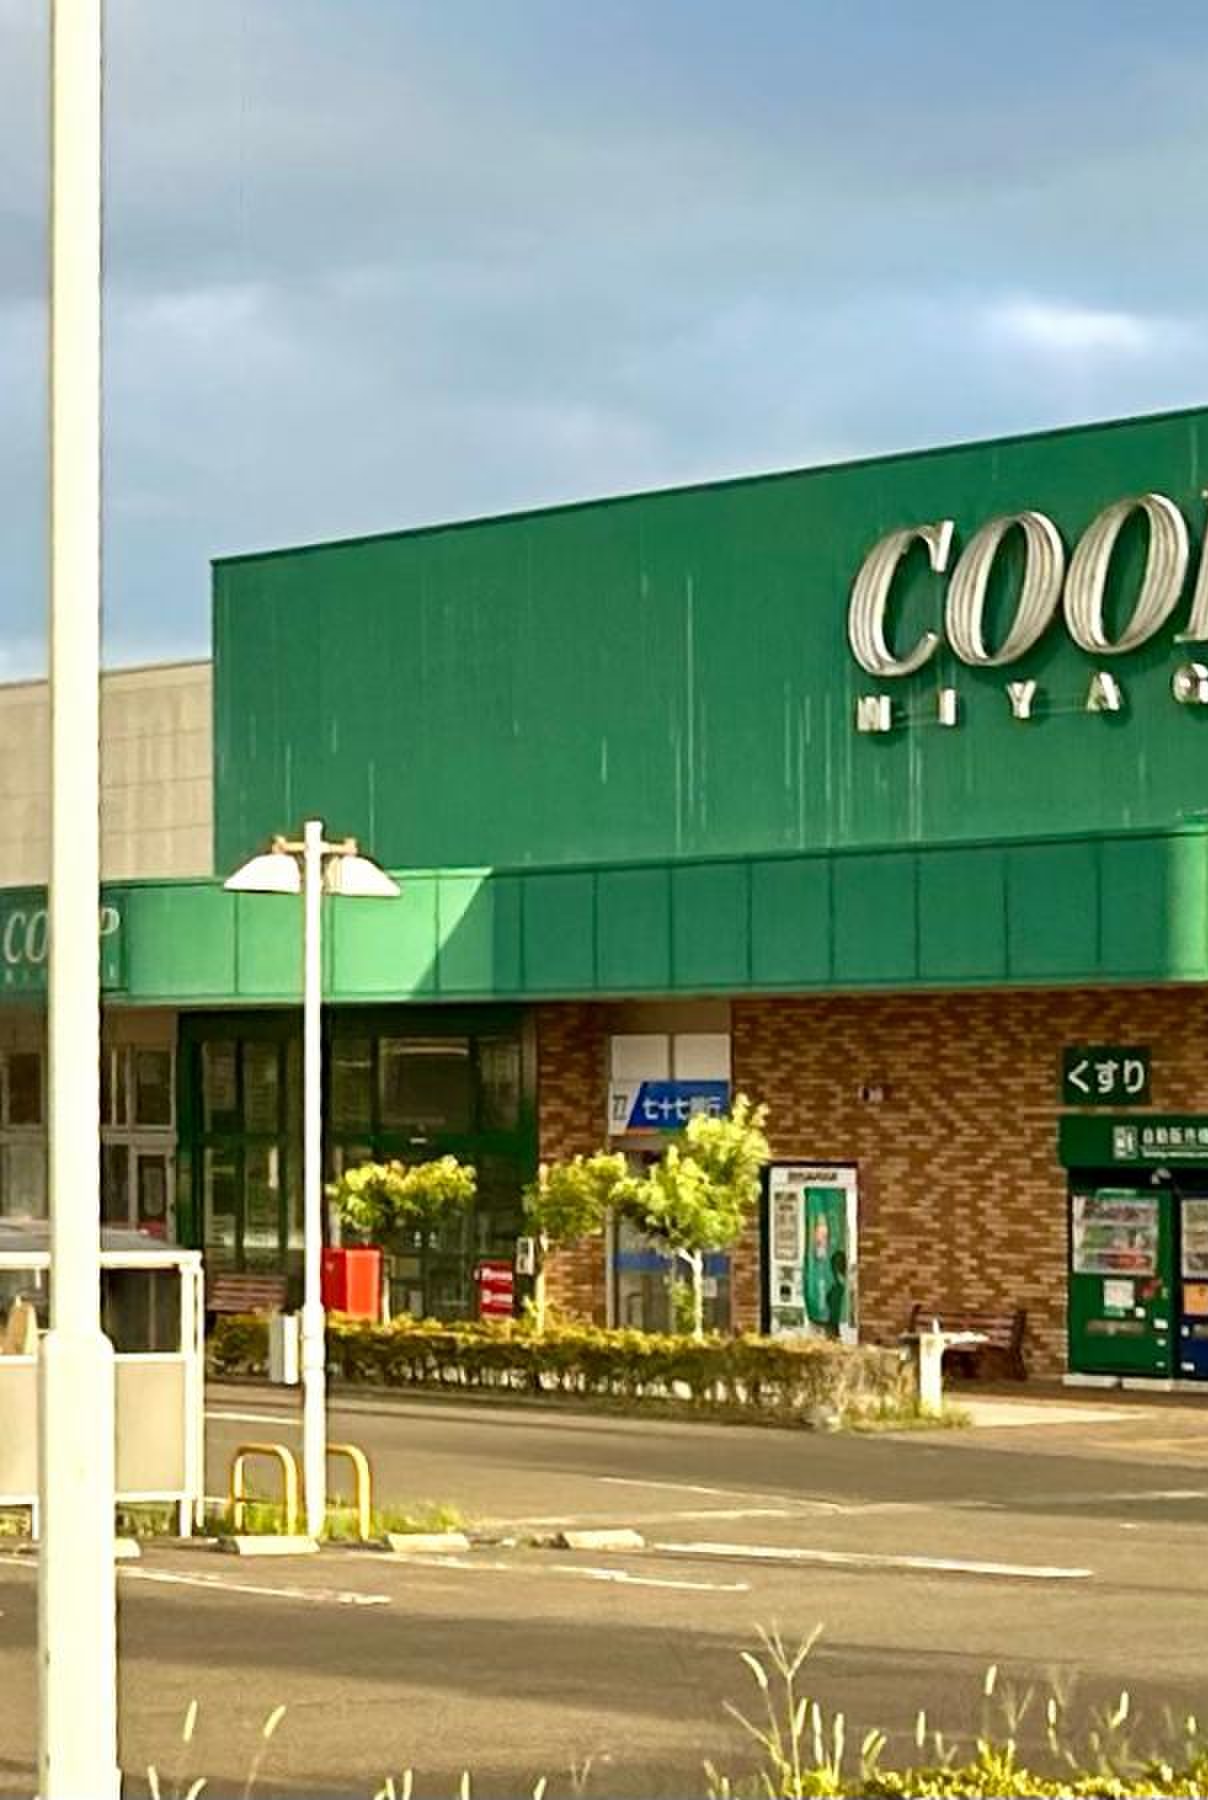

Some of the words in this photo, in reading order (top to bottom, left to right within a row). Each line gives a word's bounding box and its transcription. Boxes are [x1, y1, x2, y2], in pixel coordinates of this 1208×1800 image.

[3, 906, 121, 964] COP
[1068, 1060, 1145, 1094] くすり
